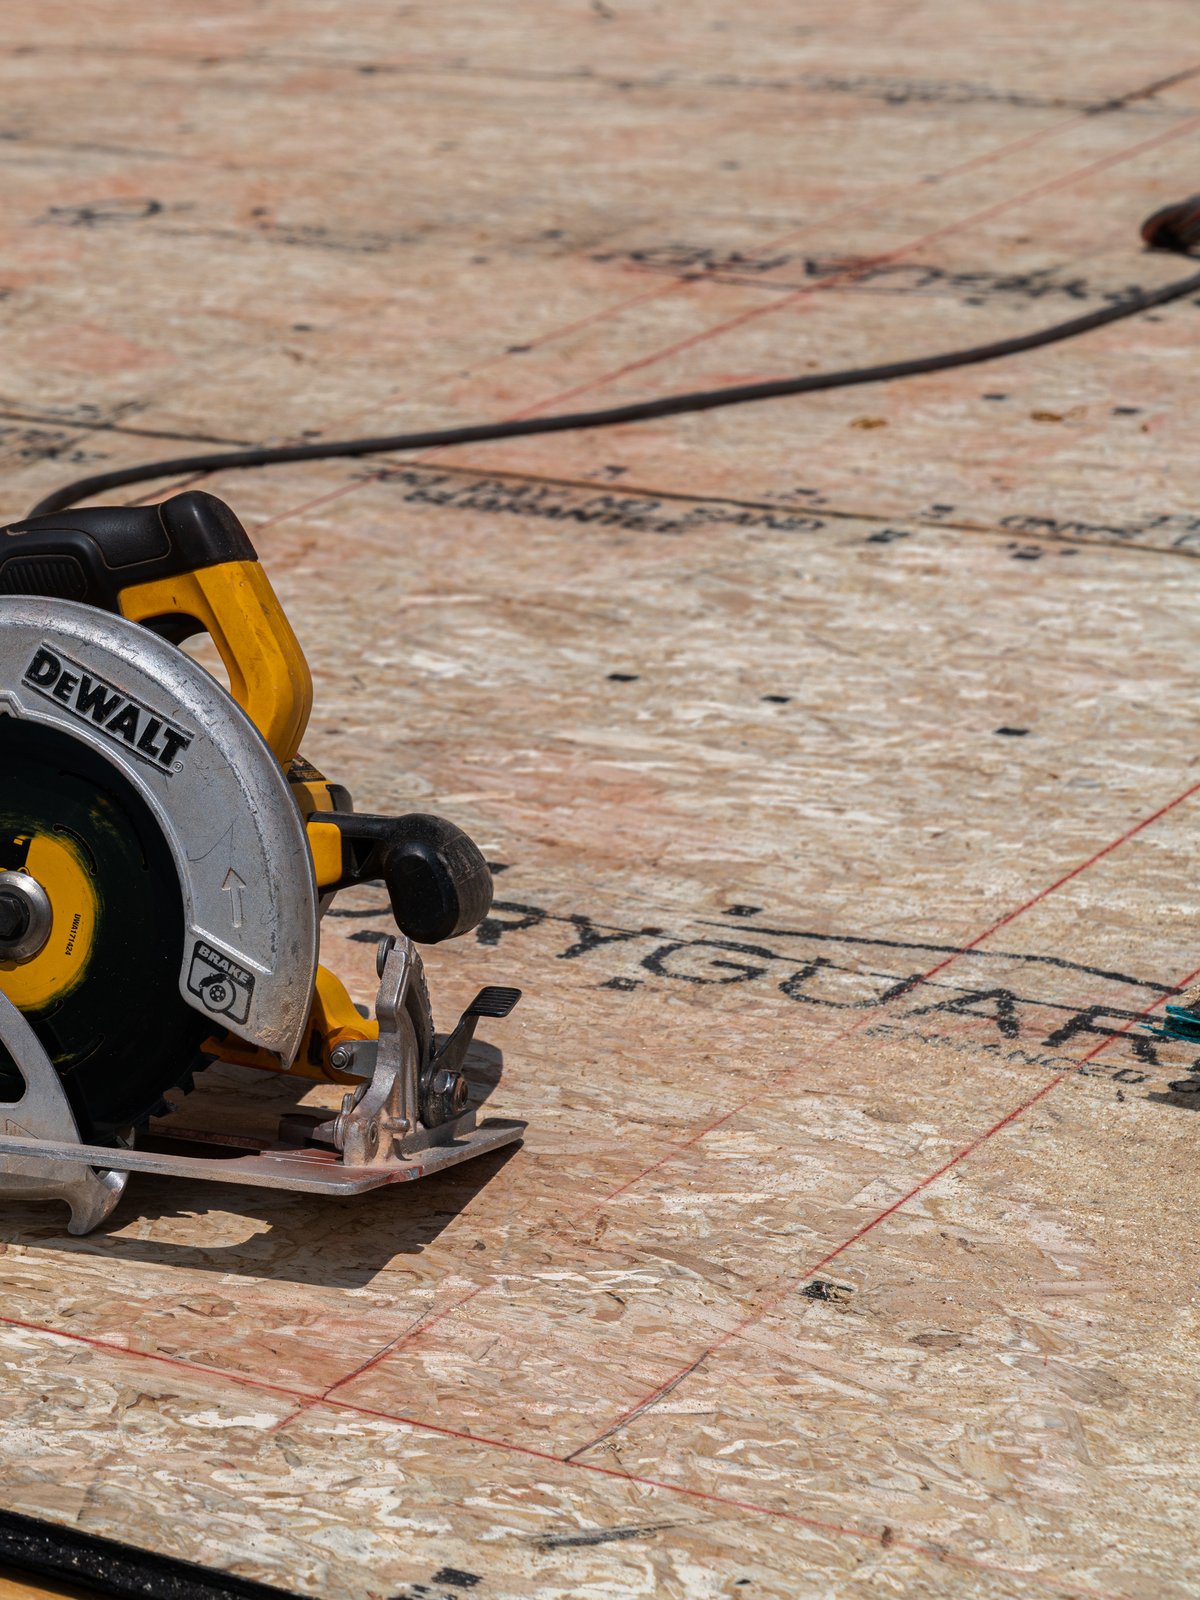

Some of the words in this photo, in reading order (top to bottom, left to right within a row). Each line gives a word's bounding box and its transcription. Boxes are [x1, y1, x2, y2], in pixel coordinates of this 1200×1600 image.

[23, 646, 192, 768] DEWALT
[64, 913, 81, 956] DWA171424
[198, 944, 250, 984] BRAKE
